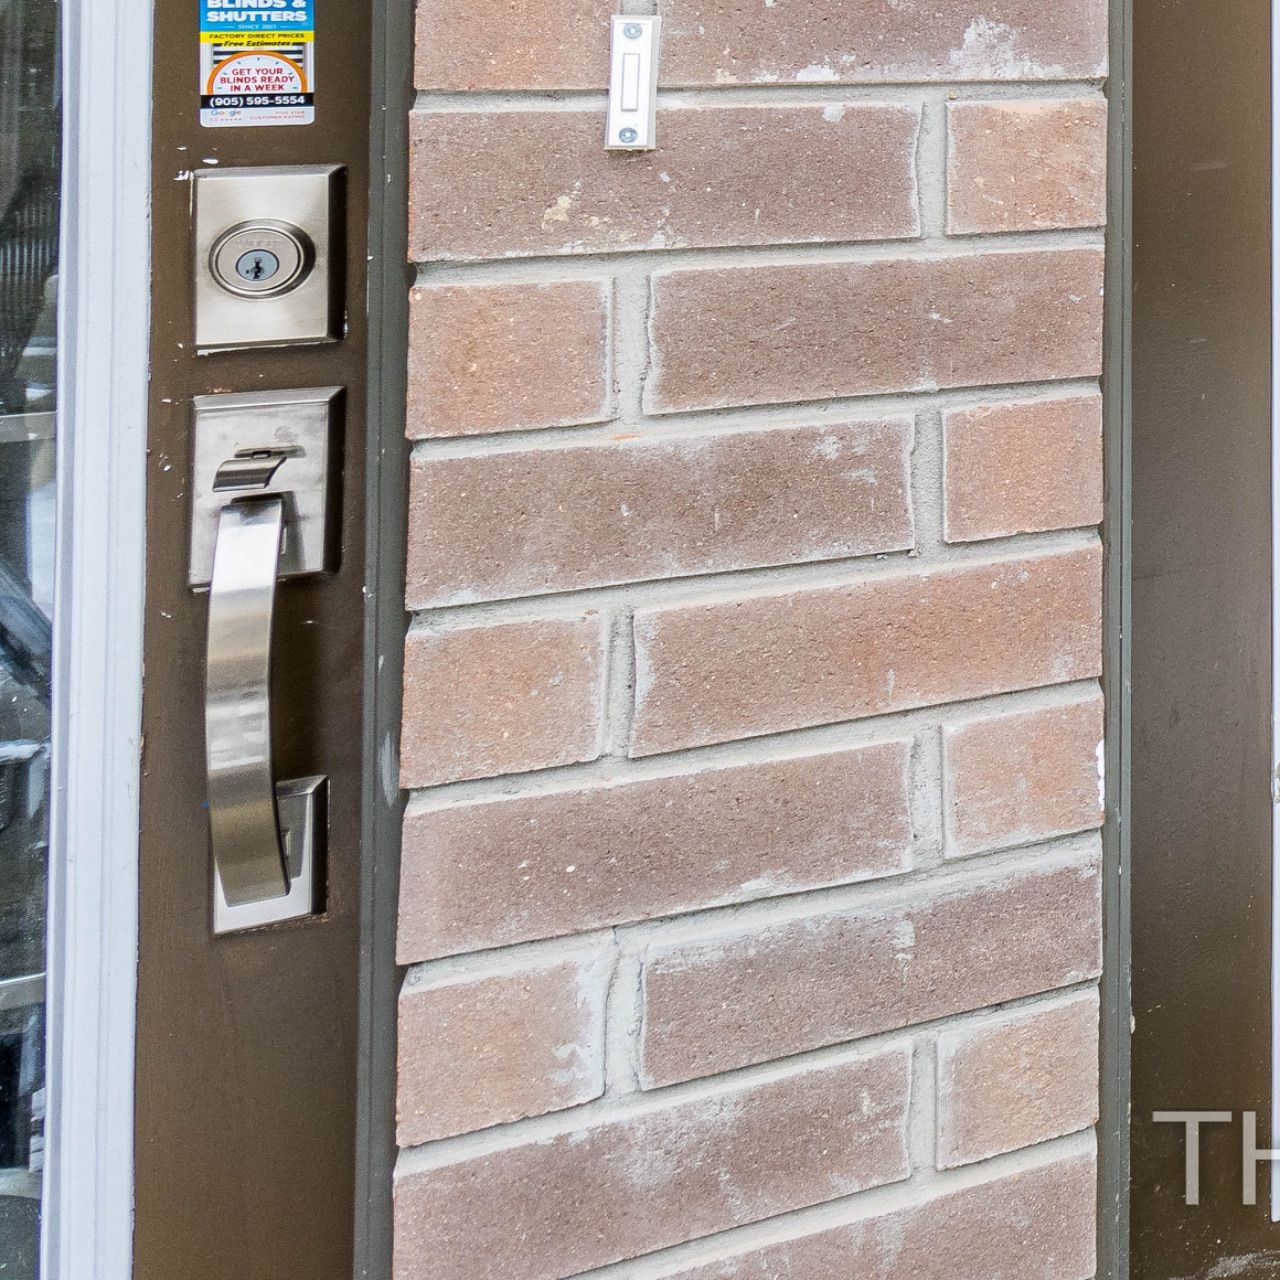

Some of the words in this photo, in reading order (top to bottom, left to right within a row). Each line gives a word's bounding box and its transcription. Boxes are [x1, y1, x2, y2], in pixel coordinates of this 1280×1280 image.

[206, 11, 307, 22] SHUTTERS
[220, 76, 257, 84] BLINDS
[210, 97, 244, 107] (905)
